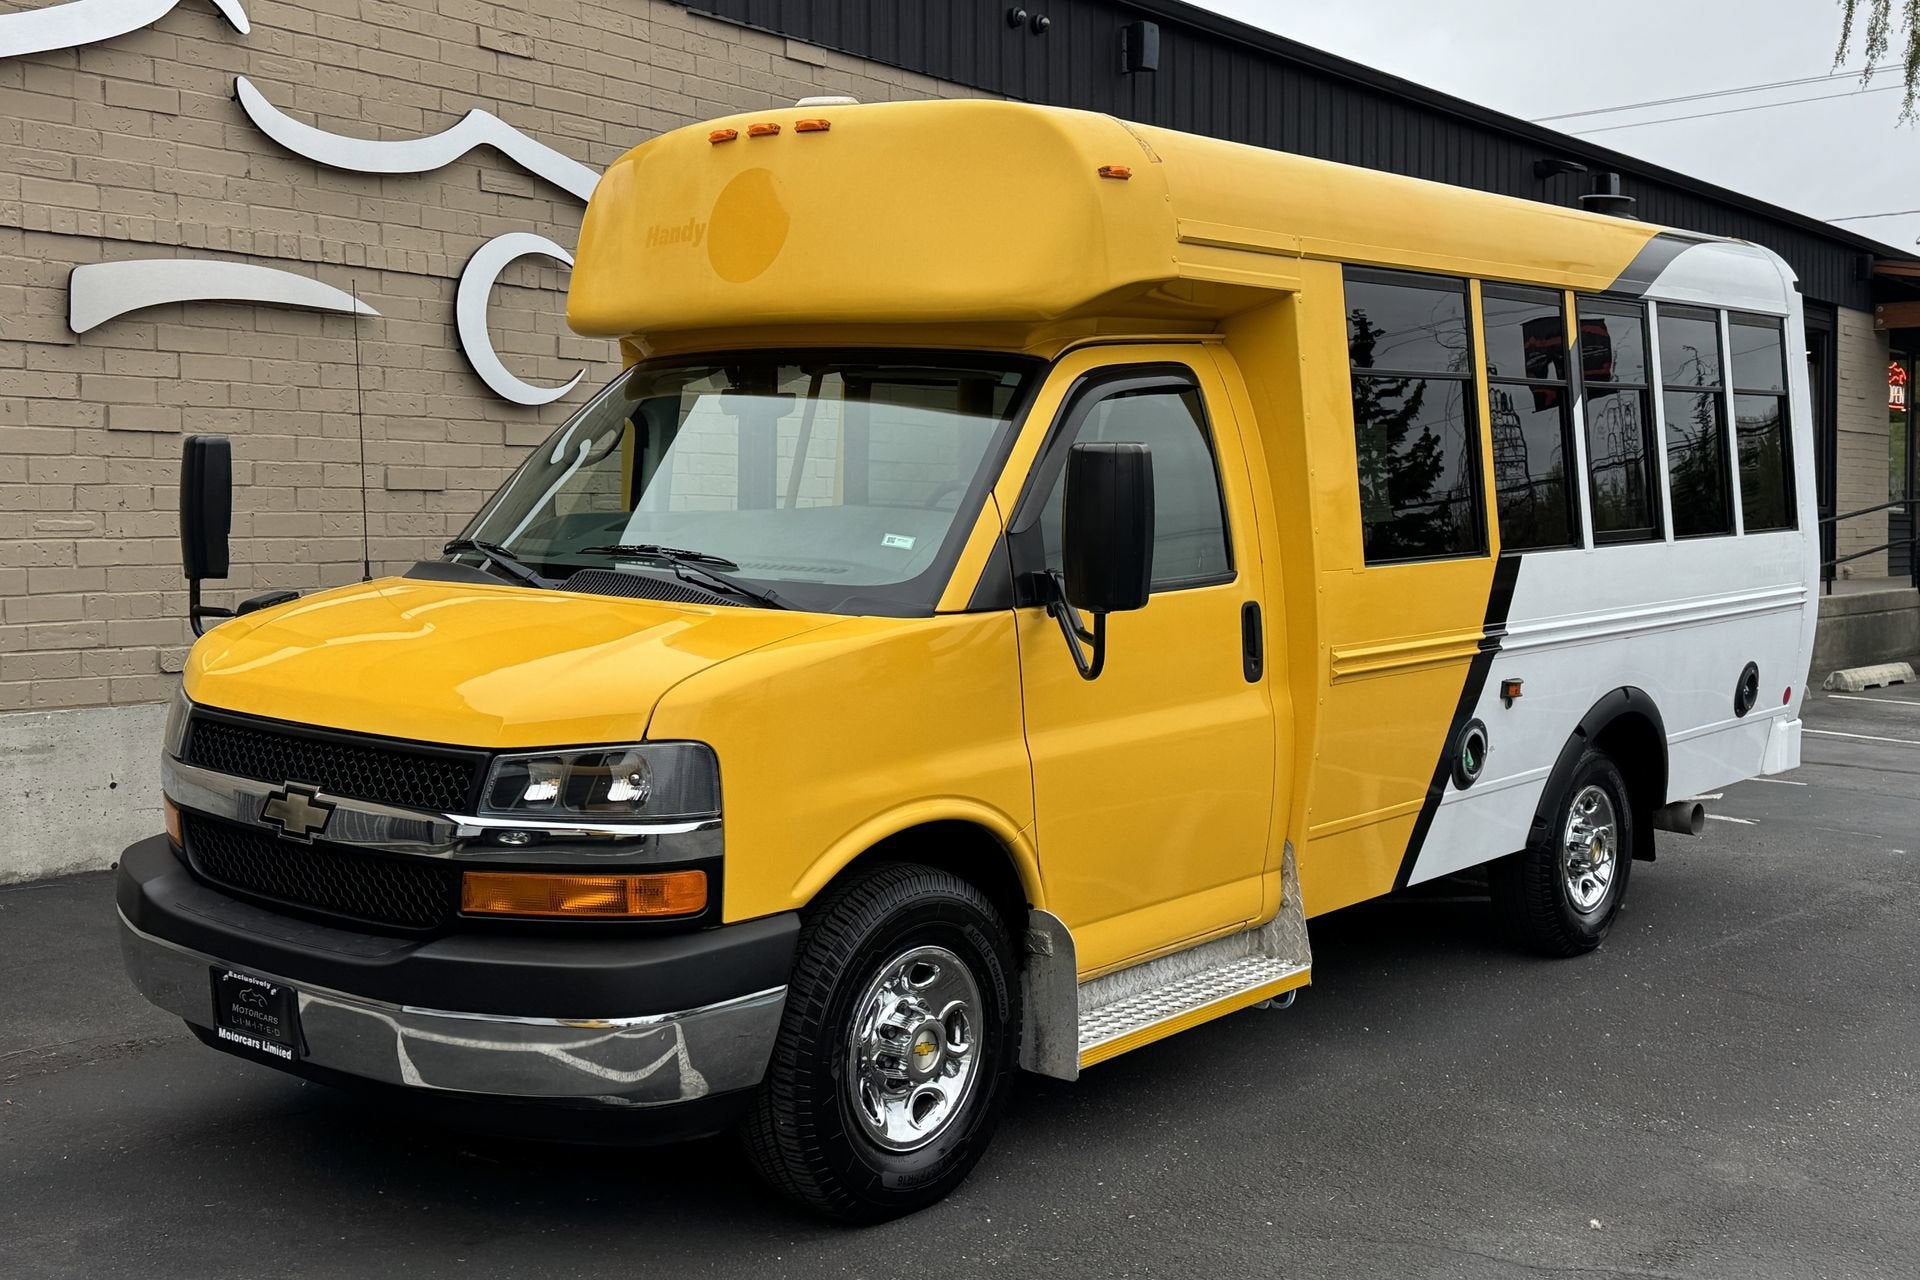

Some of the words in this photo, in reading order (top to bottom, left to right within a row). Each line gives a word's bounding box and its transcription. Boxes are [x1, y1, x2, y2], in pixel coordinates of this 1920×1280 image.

[646, 218, 707, 248] Handy
[967, 929, 992, 958] AGILIS
[229, 970, 271, 989] Exclusively
[232, 1003, 279, 1025] MOTORCARS
[218, 1027, 260, 1049] Motorcars
[262, 1041, 292, 1060] Limited
